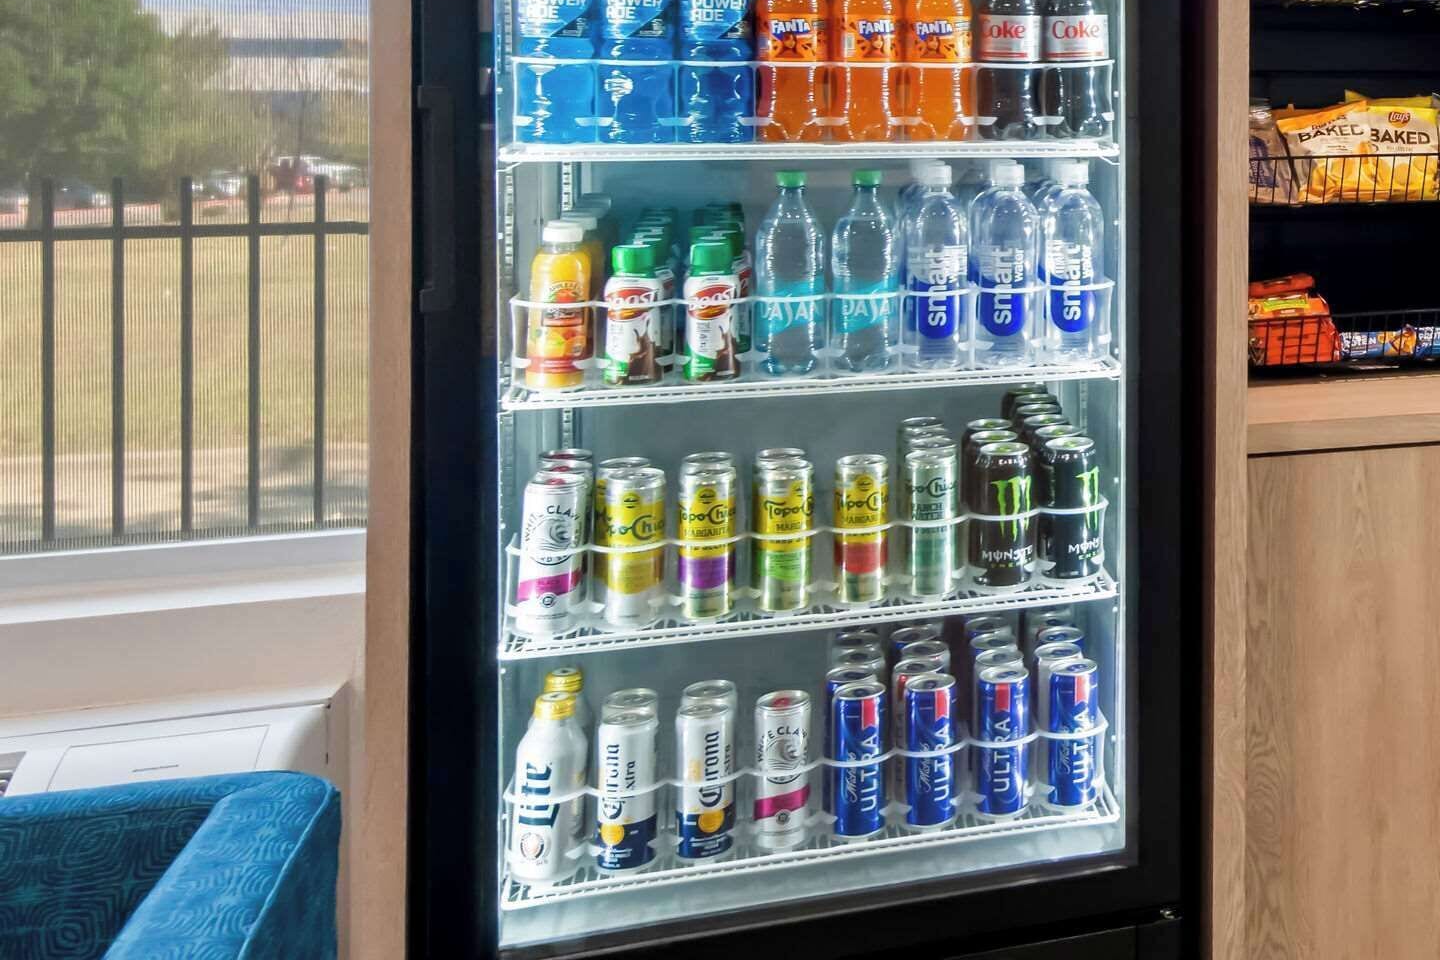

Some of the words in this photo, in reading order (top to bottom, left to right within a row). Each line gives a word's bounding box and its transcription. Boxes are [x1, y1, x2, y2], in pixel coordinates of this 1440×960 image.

[772, 18, 811, 34] FANTA
[1052, 20, 1101, 39] Coke
[1389, 111, 1410, 123] Lay's
[1299, 124, 1365, 143] BAKED
[1370, 128, 1431, 145] BAKED
[1014, 248, 1024, 282] water
[993, 247, 1012, 326] smart
[981, 544, 1033, 562] MONSTE
[934, 723, 950, 802] ULTRA
[993, 717, 1011, 793] ULTRA
[861, 734, 878, 812] ULTRA
